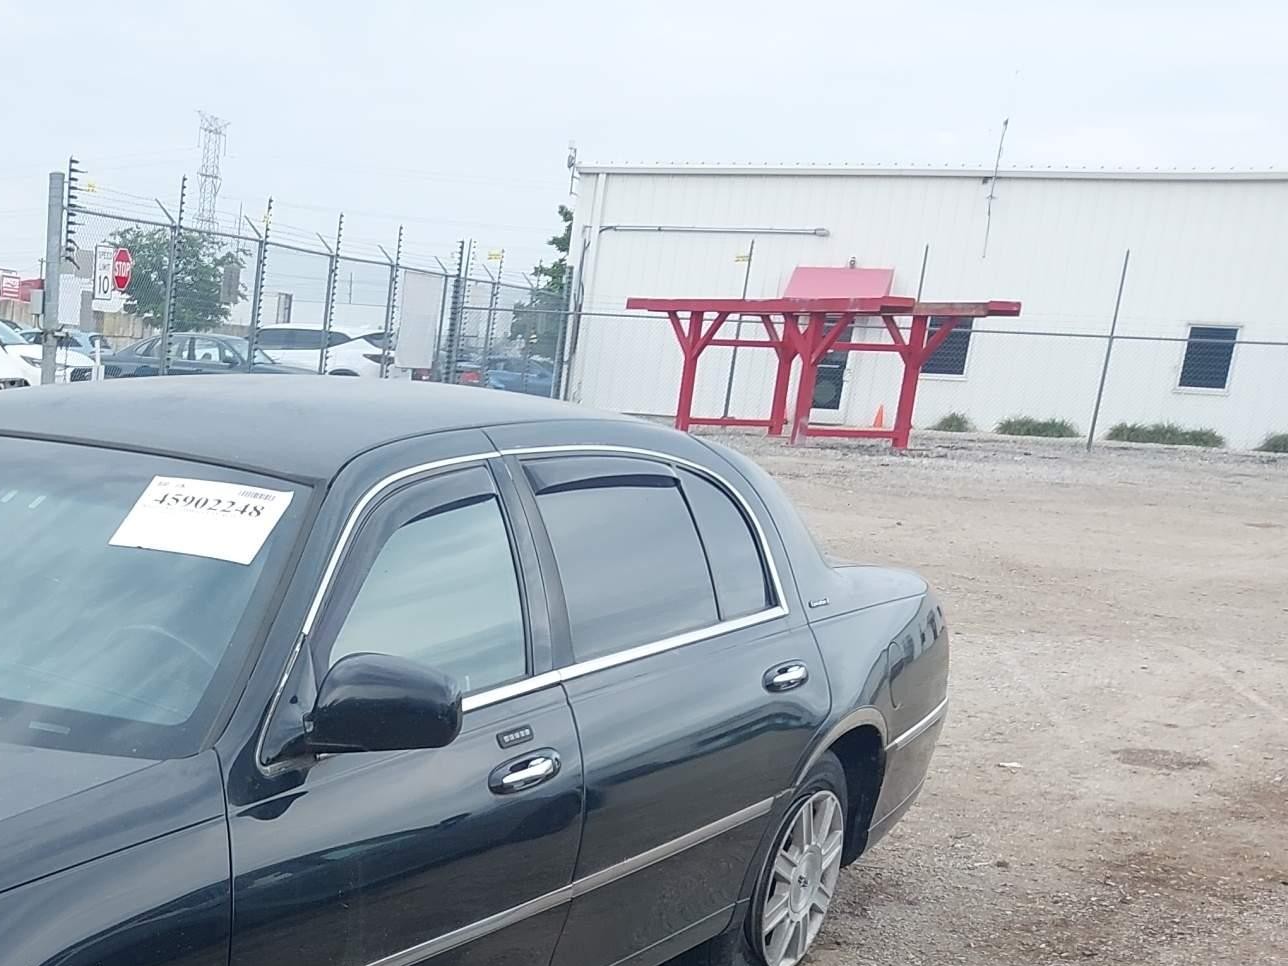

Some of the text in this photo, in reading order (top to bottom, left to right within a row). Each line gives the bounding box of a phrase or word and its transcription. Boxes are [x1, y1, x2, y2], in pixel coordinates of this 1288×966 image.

[114, 261, 131, 277] STOP
[98, 275, 110, 294] 10
[153, 493, 264, 517] 45902248
